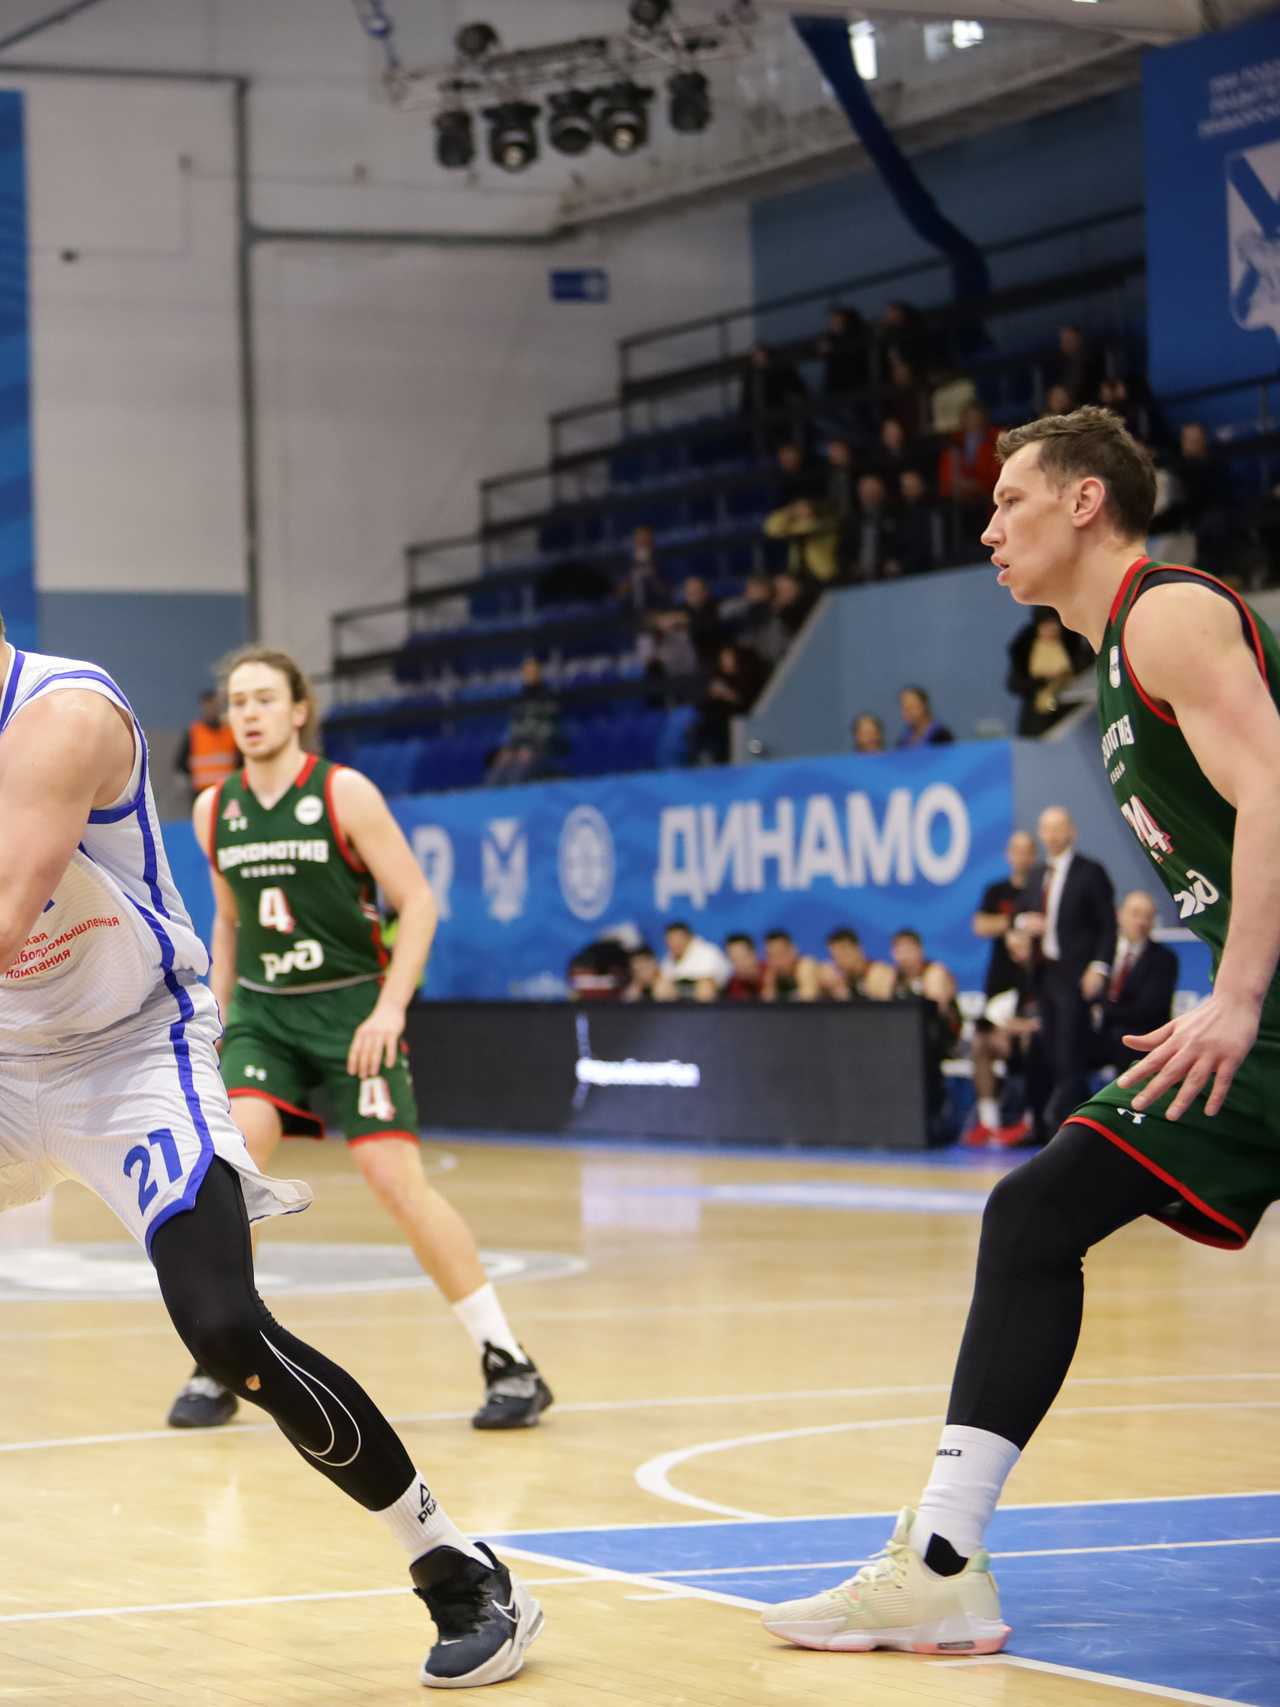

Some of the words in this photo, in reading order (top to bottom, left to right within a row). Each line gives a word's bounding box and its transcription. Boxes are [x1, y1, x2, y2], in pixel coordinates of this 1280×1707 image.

[654, 783, 970, 911] ДИНАМО
[258, 887, 296, 934] 4
[359, 1076, 396, 1122] 4
[123, 1128, 183, 1217] 21
[417, 1498, 438, 1524] PEA
